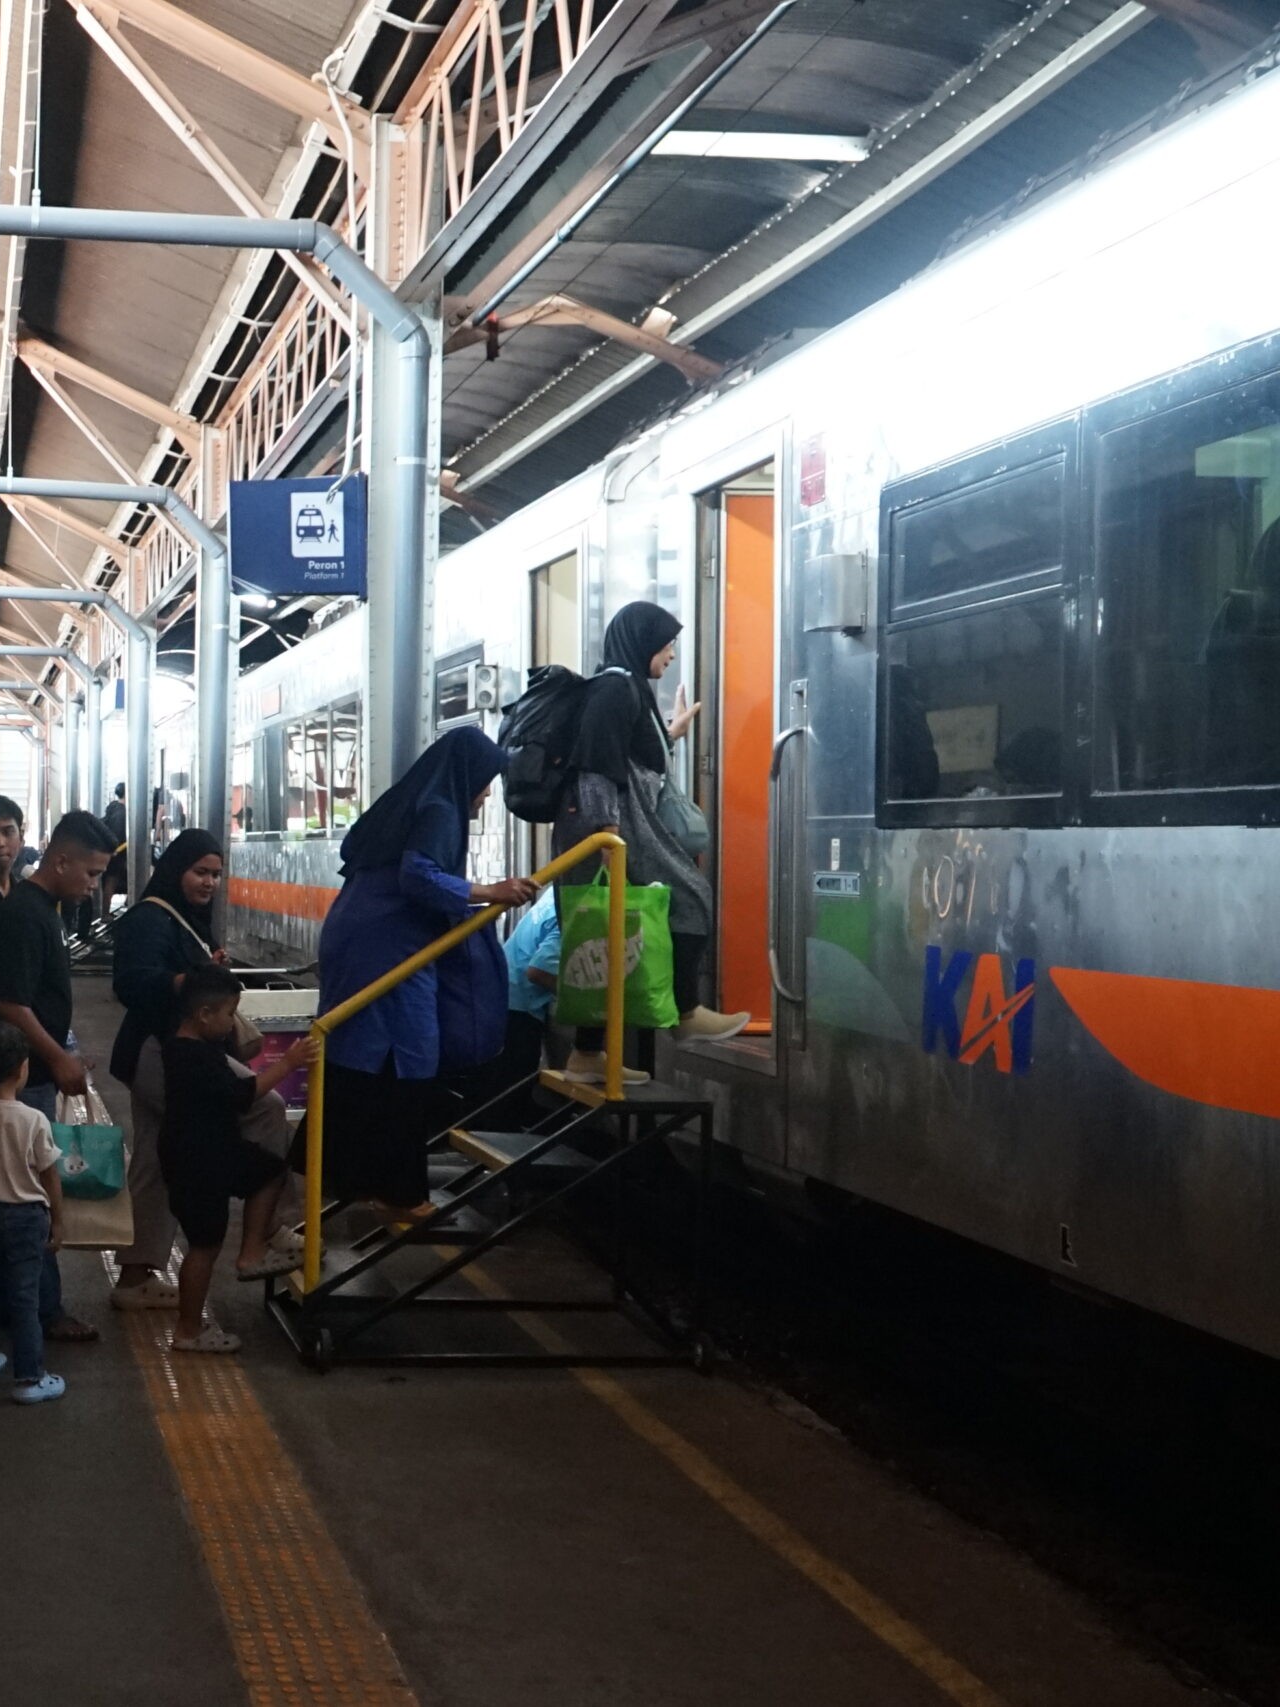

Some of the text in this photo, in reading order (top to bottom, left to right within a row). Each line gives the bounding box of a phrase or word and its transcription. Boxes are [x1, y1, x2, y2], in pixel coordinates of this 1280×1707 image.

[308, 560, 345, 570] Peron 1
[303, 571, 339, 580] Platform
[922, 945, 1035, 1076] KAI
